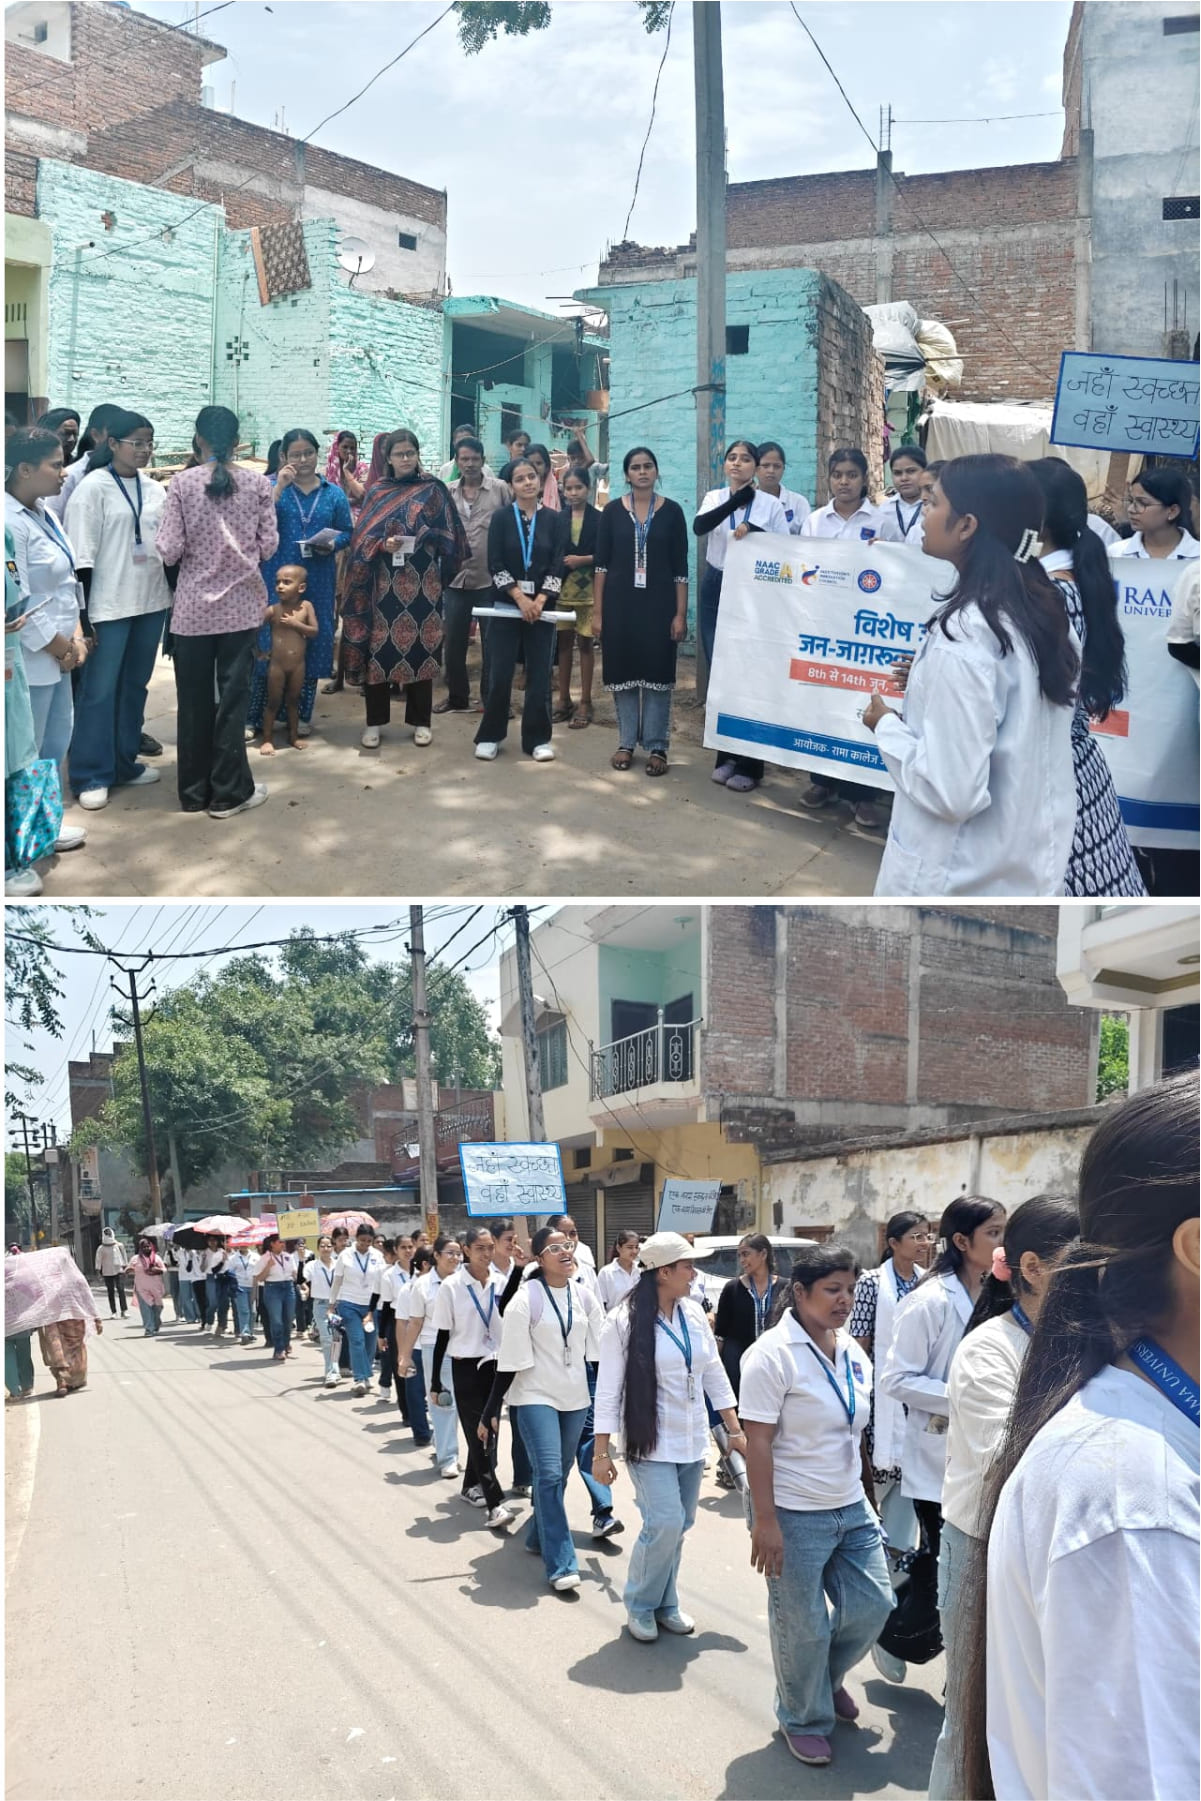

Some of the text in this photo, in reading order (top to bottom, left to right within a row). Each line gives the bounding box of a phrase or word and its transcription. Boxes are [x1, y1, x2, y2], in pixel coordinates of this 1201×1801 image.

[1067, 366, 1120, 399] जहाँ
[1073, 404, 1119, 436] वहाँ
[754, 567, 780, 577] GRADE
[755, 560, 780, 570] NAAC
[854, 608, 914, 643] विशेष
[808, 667, 826, 680] 8th
[829, 668, 839, 682] से
[841, 673, 866, 687] 14th
[831, 746, 849, 758] रामा
[850, 749, 879, 764] कालेज
[481, 1179, 510, 1203] वहाँ
